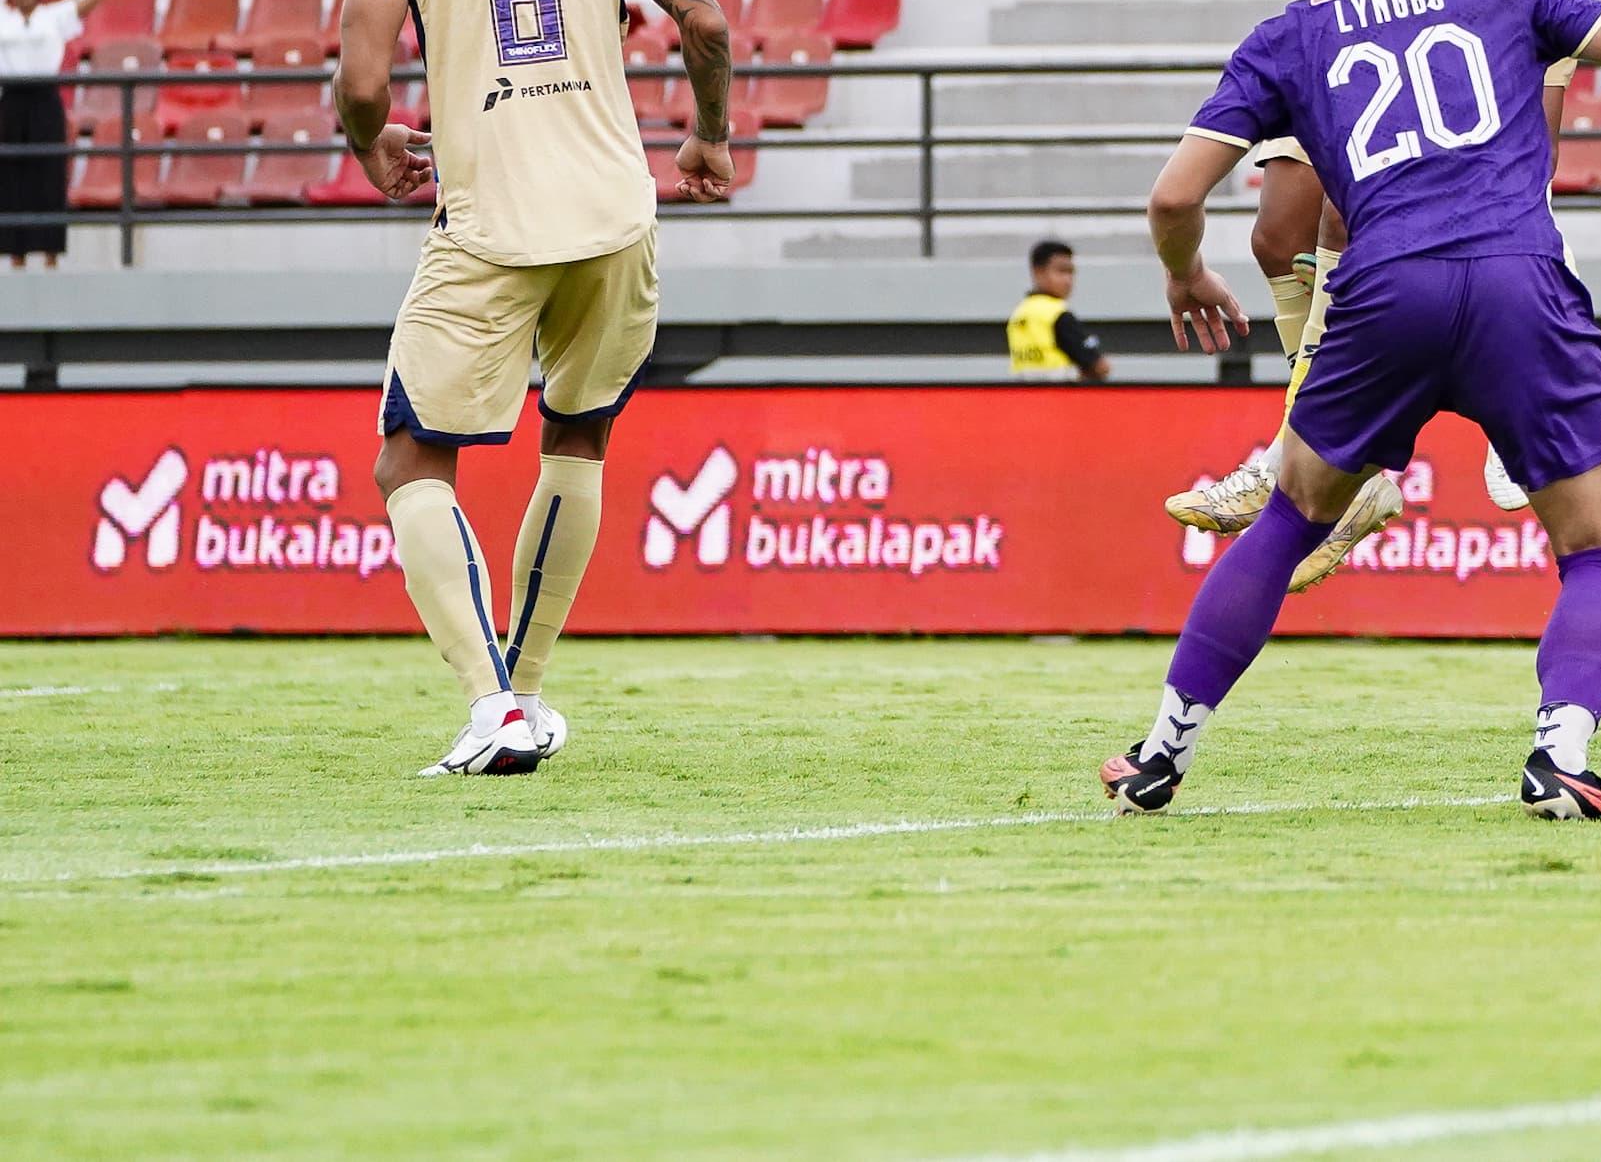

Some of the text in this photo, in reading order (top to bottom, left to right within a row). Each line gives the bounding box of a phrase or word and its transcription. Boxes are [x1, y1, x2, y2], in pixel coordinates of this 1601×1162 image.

[1327, 22, 1502, 183] 20
[203, 449, 340, 503] mitra
[753, 447, 890, 502] mitra
[195, 512, 402, 576] bukalap
[745, 513, 1002, 575] bukalapak
[1346, 517, 1552, 582] kalapak
